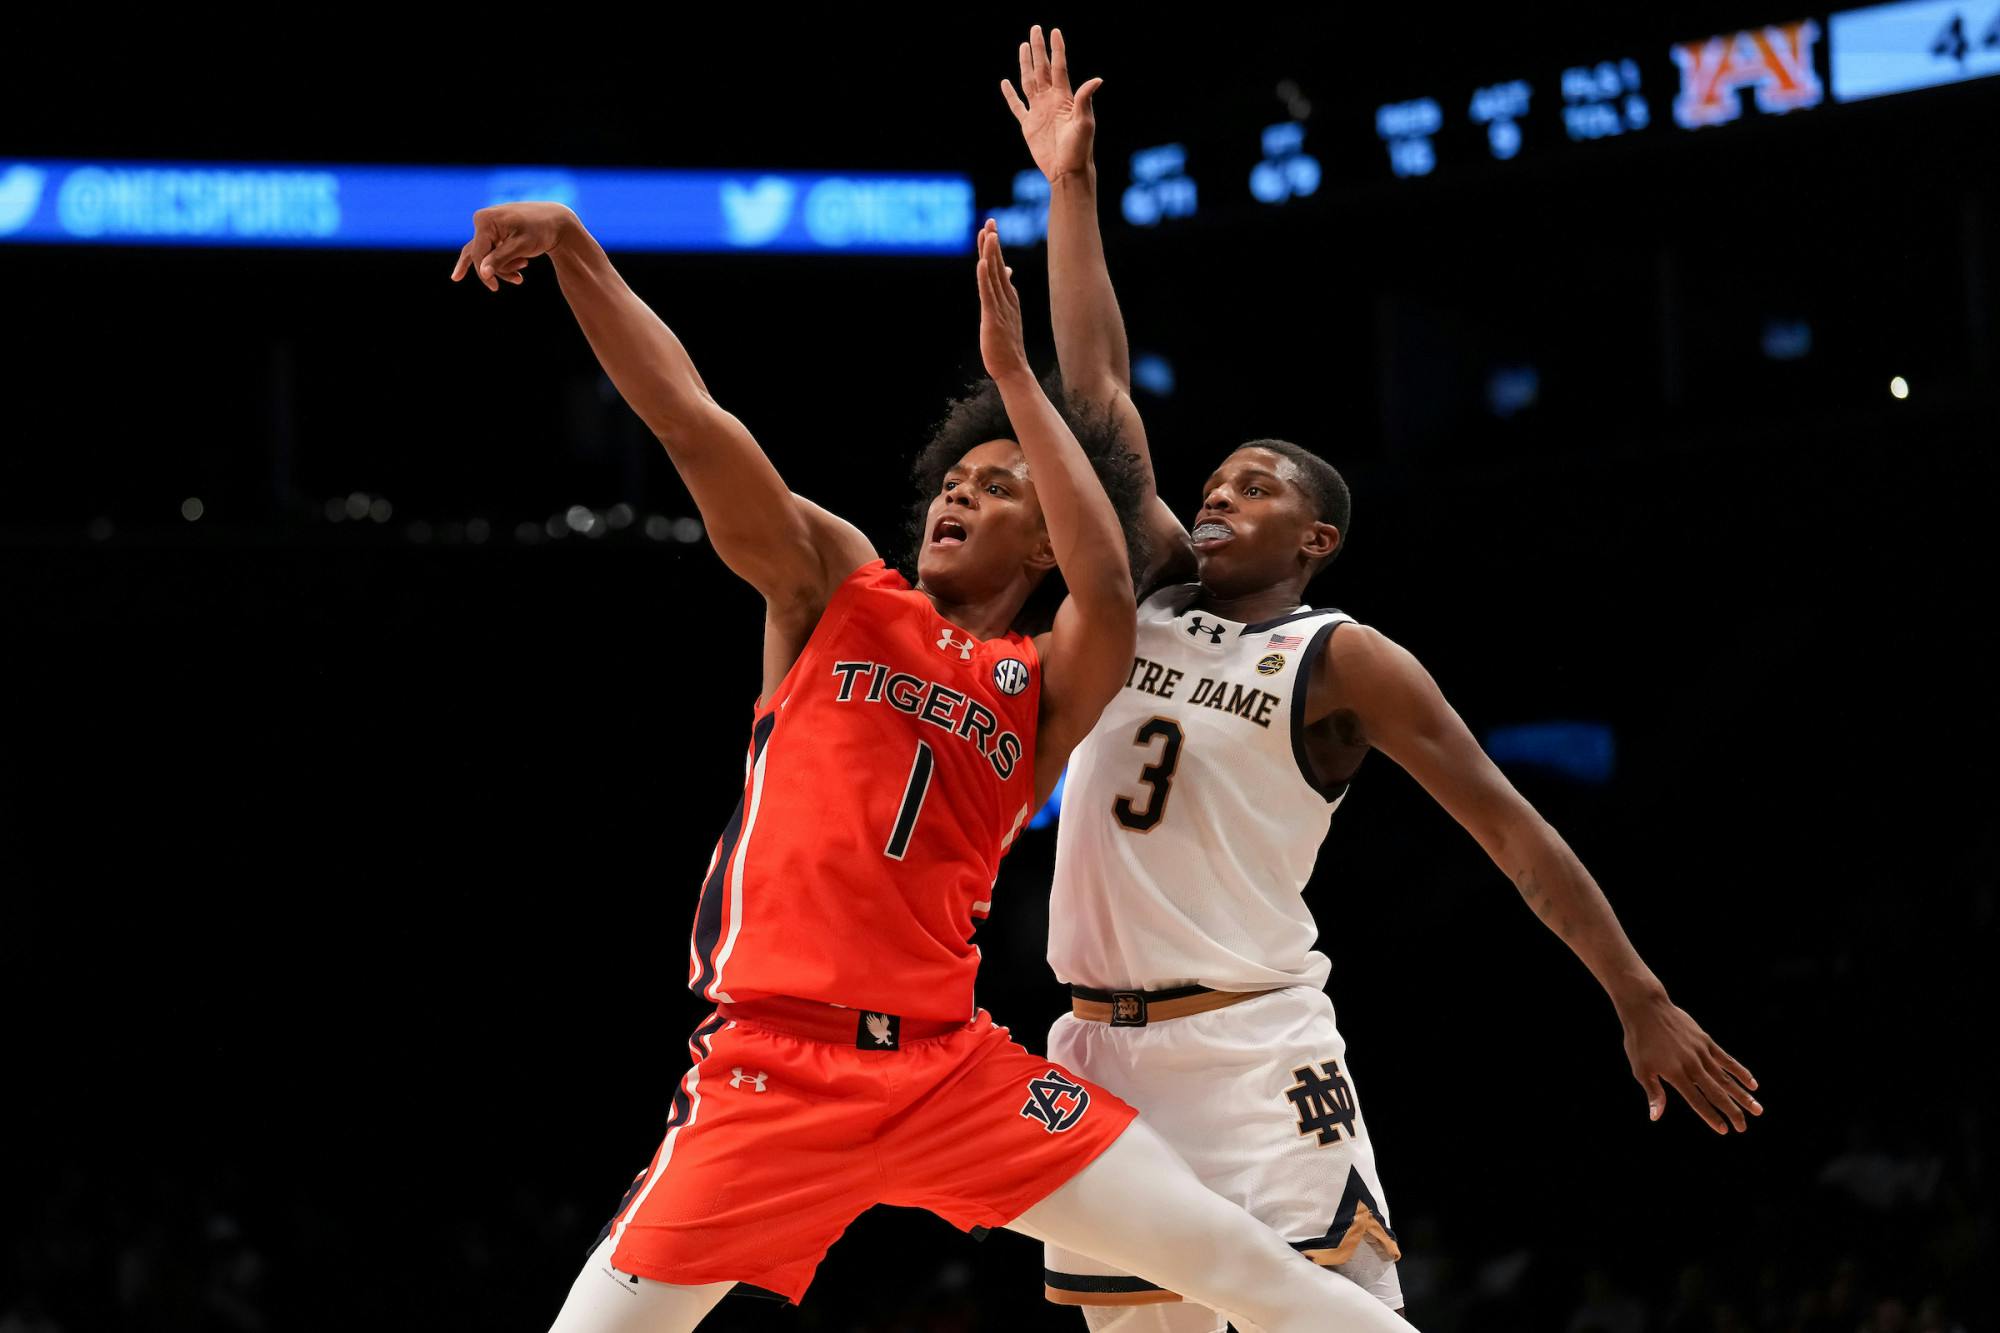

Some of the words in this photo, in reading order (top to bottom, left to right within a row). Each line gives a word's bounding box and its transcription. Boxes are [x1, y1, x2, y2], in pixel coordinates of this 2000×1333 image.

[832, 660, 1022, 781] TIGERS
[995, 659, 1028, 695] SEC
[1125, 656, 1185, 700] TRE
[1187, 677, 1281, 729] DAME
[884, 739, 934, 861] 1
[1111, 715, 1185, 835] 3
